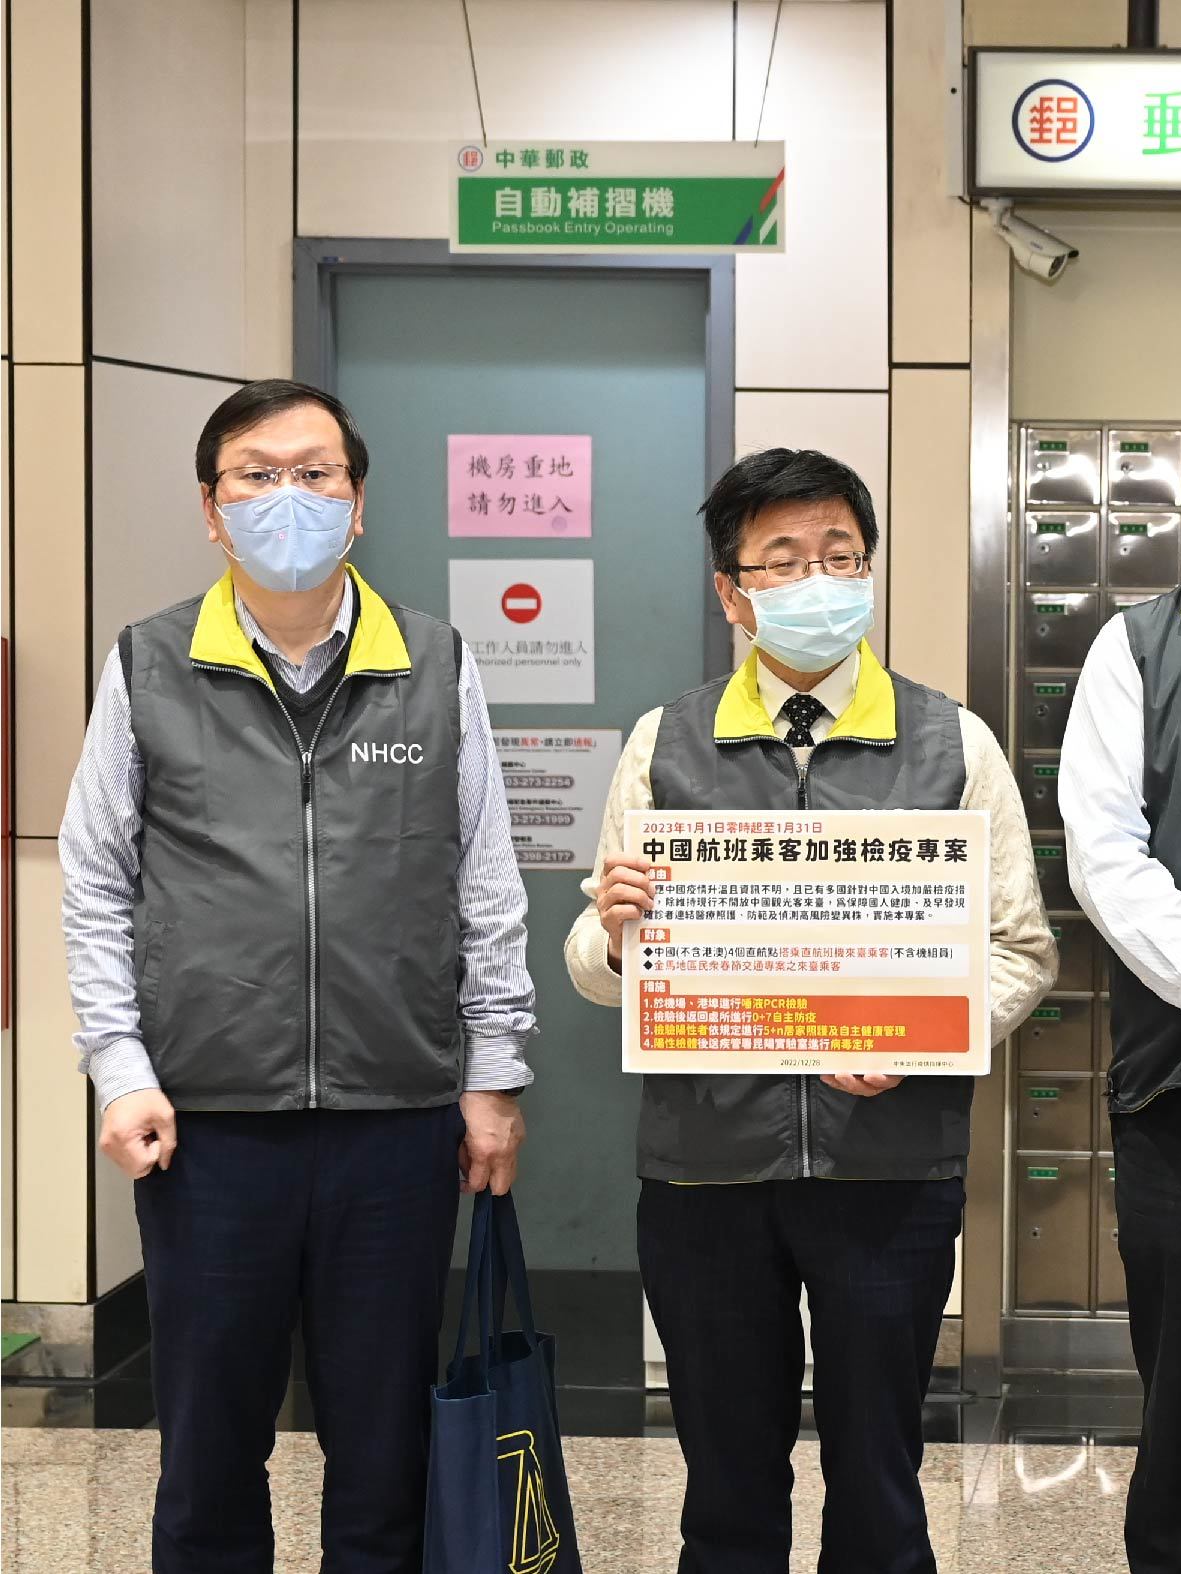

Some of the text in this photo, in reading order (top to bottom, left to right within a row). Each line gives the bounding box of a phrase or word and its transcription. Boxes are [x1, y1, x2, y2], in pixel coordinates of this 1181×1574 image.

[495, 148, 590, 169] 中華郵政
[494, 187, 674, 218] 自動補摺機
[492, 221, 674, 236] Passbook Entry Operating
[467, 454, 574, 479] 機房重地
[467, 493, 573, 516] 請勿進入
[515, 658, 560, 667] personnel
[563, 658, 582, 667] only
[351, 741, 424, 765] NHCC
[643, 821, 823, 835] 2023年1月1日零時起至1月31日
[642, 837, 968, 863] 中國航班乘客加強檢疫專案
[644, 929, 666, 941] 對象
[643, 981, 666, 993] 措施
